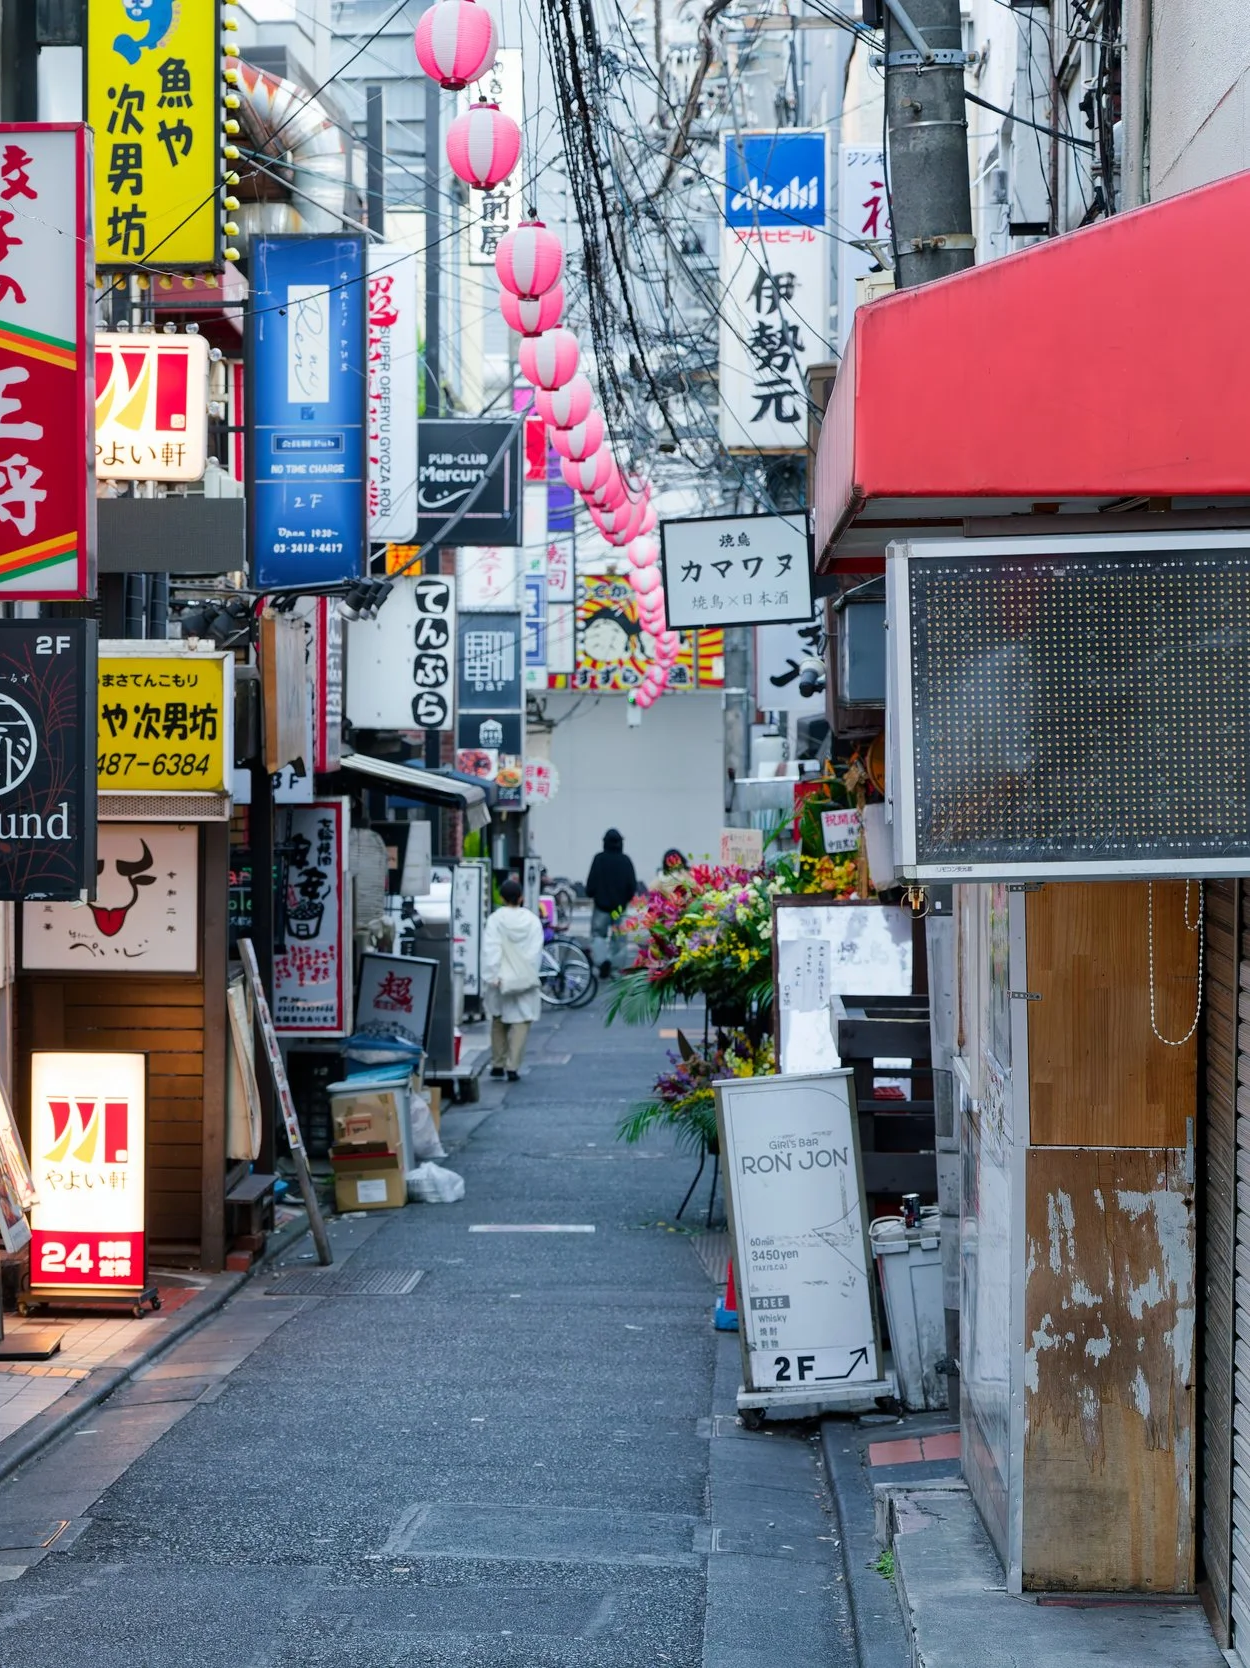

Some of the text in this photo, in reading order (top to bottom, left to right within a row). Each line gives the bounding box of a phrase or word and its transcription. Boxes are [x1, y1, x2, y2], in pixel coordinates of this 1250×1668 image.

[157, 57, 193, 167] 魚や
[107, 83, 147, 256] 次男坊
[731, 175, 818, 211] Asahi
[734, 229, 815, 243] アサヒビール
[380, 326, 391, 371] SUPER
[746, 264, 804, 424] 伊勢元
[271, 463, 345, 474] NO TIME CHARGE
[380, 437, 391, 485] GYOZA
[719, 532, 751, 548] 焼鳥
[681, 554, 793, 582] カマワヌ
[36, 635, 71, 654] 2F
[411, 580, 449, 727] てんぷら
[97, 673, 198, 688] まさてんこもり
[97, 702, 218, 741] や次男坊
[769, 1137, 819, 1151] Girl's Bar
[741, 1146, 849, 1175] RON JON
[44, 1169, 129, 1191] やよい軒
[750, 1237, 775, 1247] 60min
[41, 1241, 93, 1274] 24
[756, 1297, 784, 1309] FREE
[758, 1314, 787, 1324] Whisky
[773, 1355, 815, 1382] 2F
